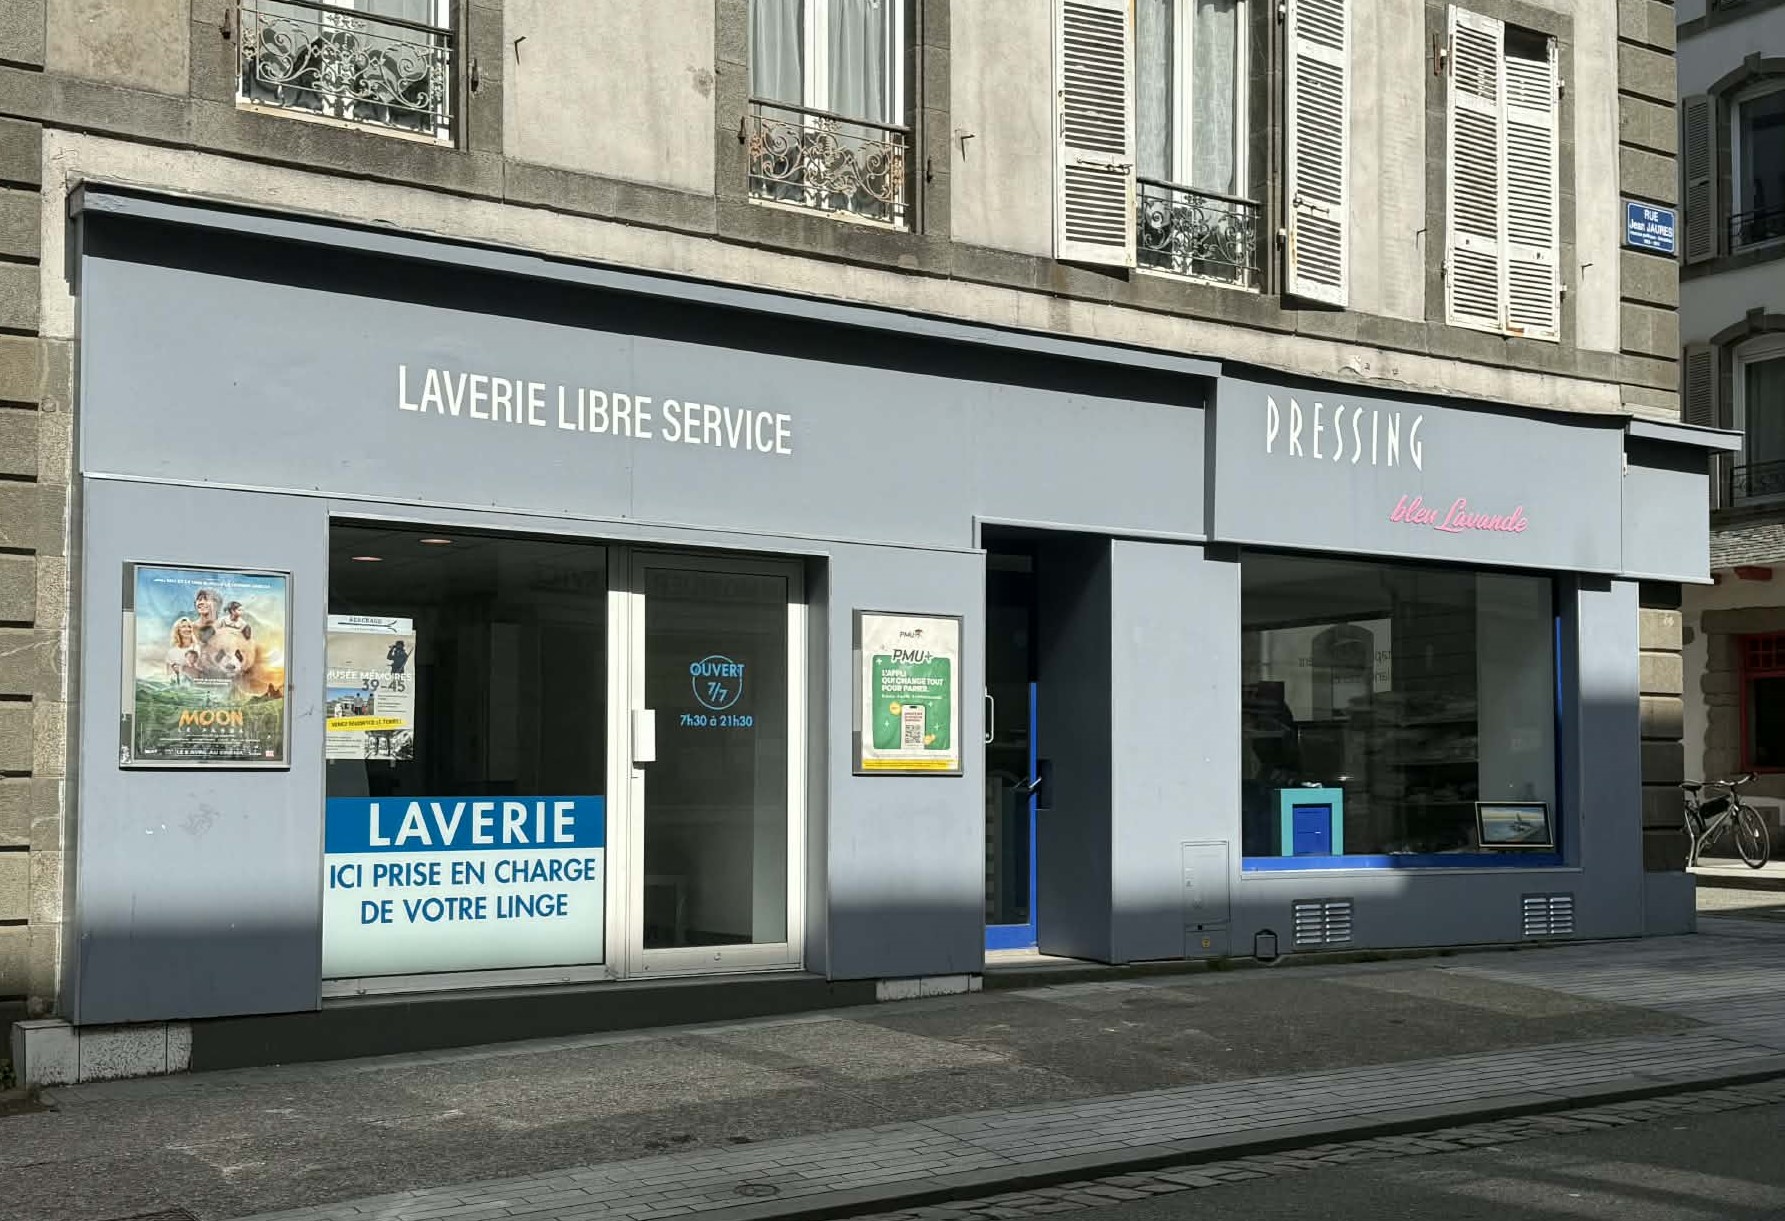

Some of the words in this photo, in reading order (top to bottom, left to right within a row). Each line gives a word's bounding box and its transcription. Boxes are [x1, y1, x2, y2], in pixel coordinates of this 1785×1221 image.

[1644, 209, 1659, 222] RUE
[399, 364, 546, 427] LAVERIE
[558, 385, 653, 439] LIBRE
[661, 399, 793, 455] SERVICE
[1266, 395, 1424, 471] PRESSING
[1433, 498, 1529, 533] Lavande
[690, 662, 745, 677] OUVERT
[361, 679, 405, 692] 39-45
[707, 681, 728, 703] 7/7
[926, 678, 944, 687] TOUT
[178, 710, 244, 728] MOON
[680, 714, 707, 727] 7h30
[719, 714, 753, 727] 21h30
[369, 801, 575, 846] LAVERIE
[330, 864, 362, 888] ICI
[373, 862, 441, 888] PRISE
[451, 861, 485, 885] EN
[495, 858, 596, 884] CHARGE
[361, 900, 394, 924] DE
[403, 896, 487, 923] VOTRE
[497, 893, 568, 919] LINGE
